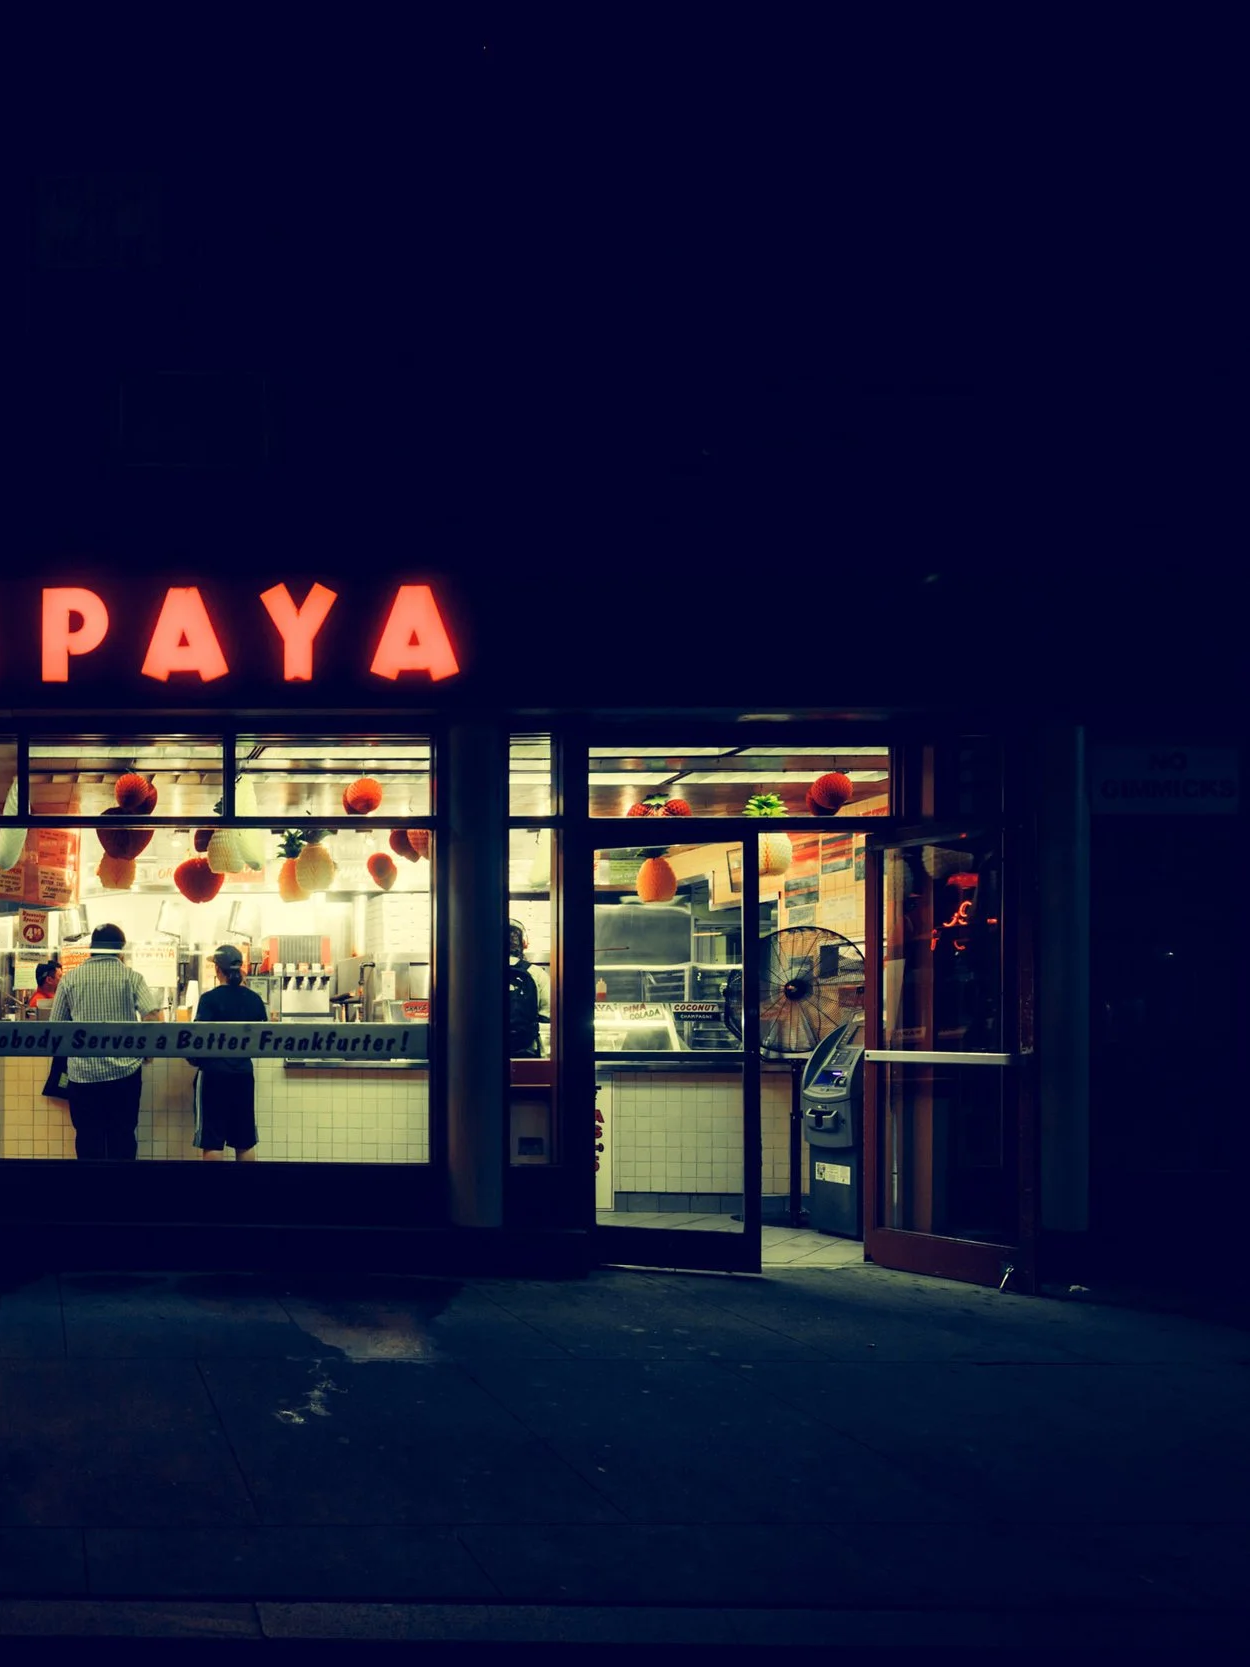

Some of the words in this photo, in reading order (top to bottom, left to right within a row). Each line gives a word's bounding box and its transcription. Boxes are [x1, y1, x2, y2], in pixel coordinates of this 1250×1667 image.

[673, 1003, 717, 1012] COCONUT
[71, 1028, 147, 1050] Serves
[156, 1033, 167, 1050] a
[176, 1029, 250, 1051] Better
[259, 1030, 410, 1052] Frankfurter!
